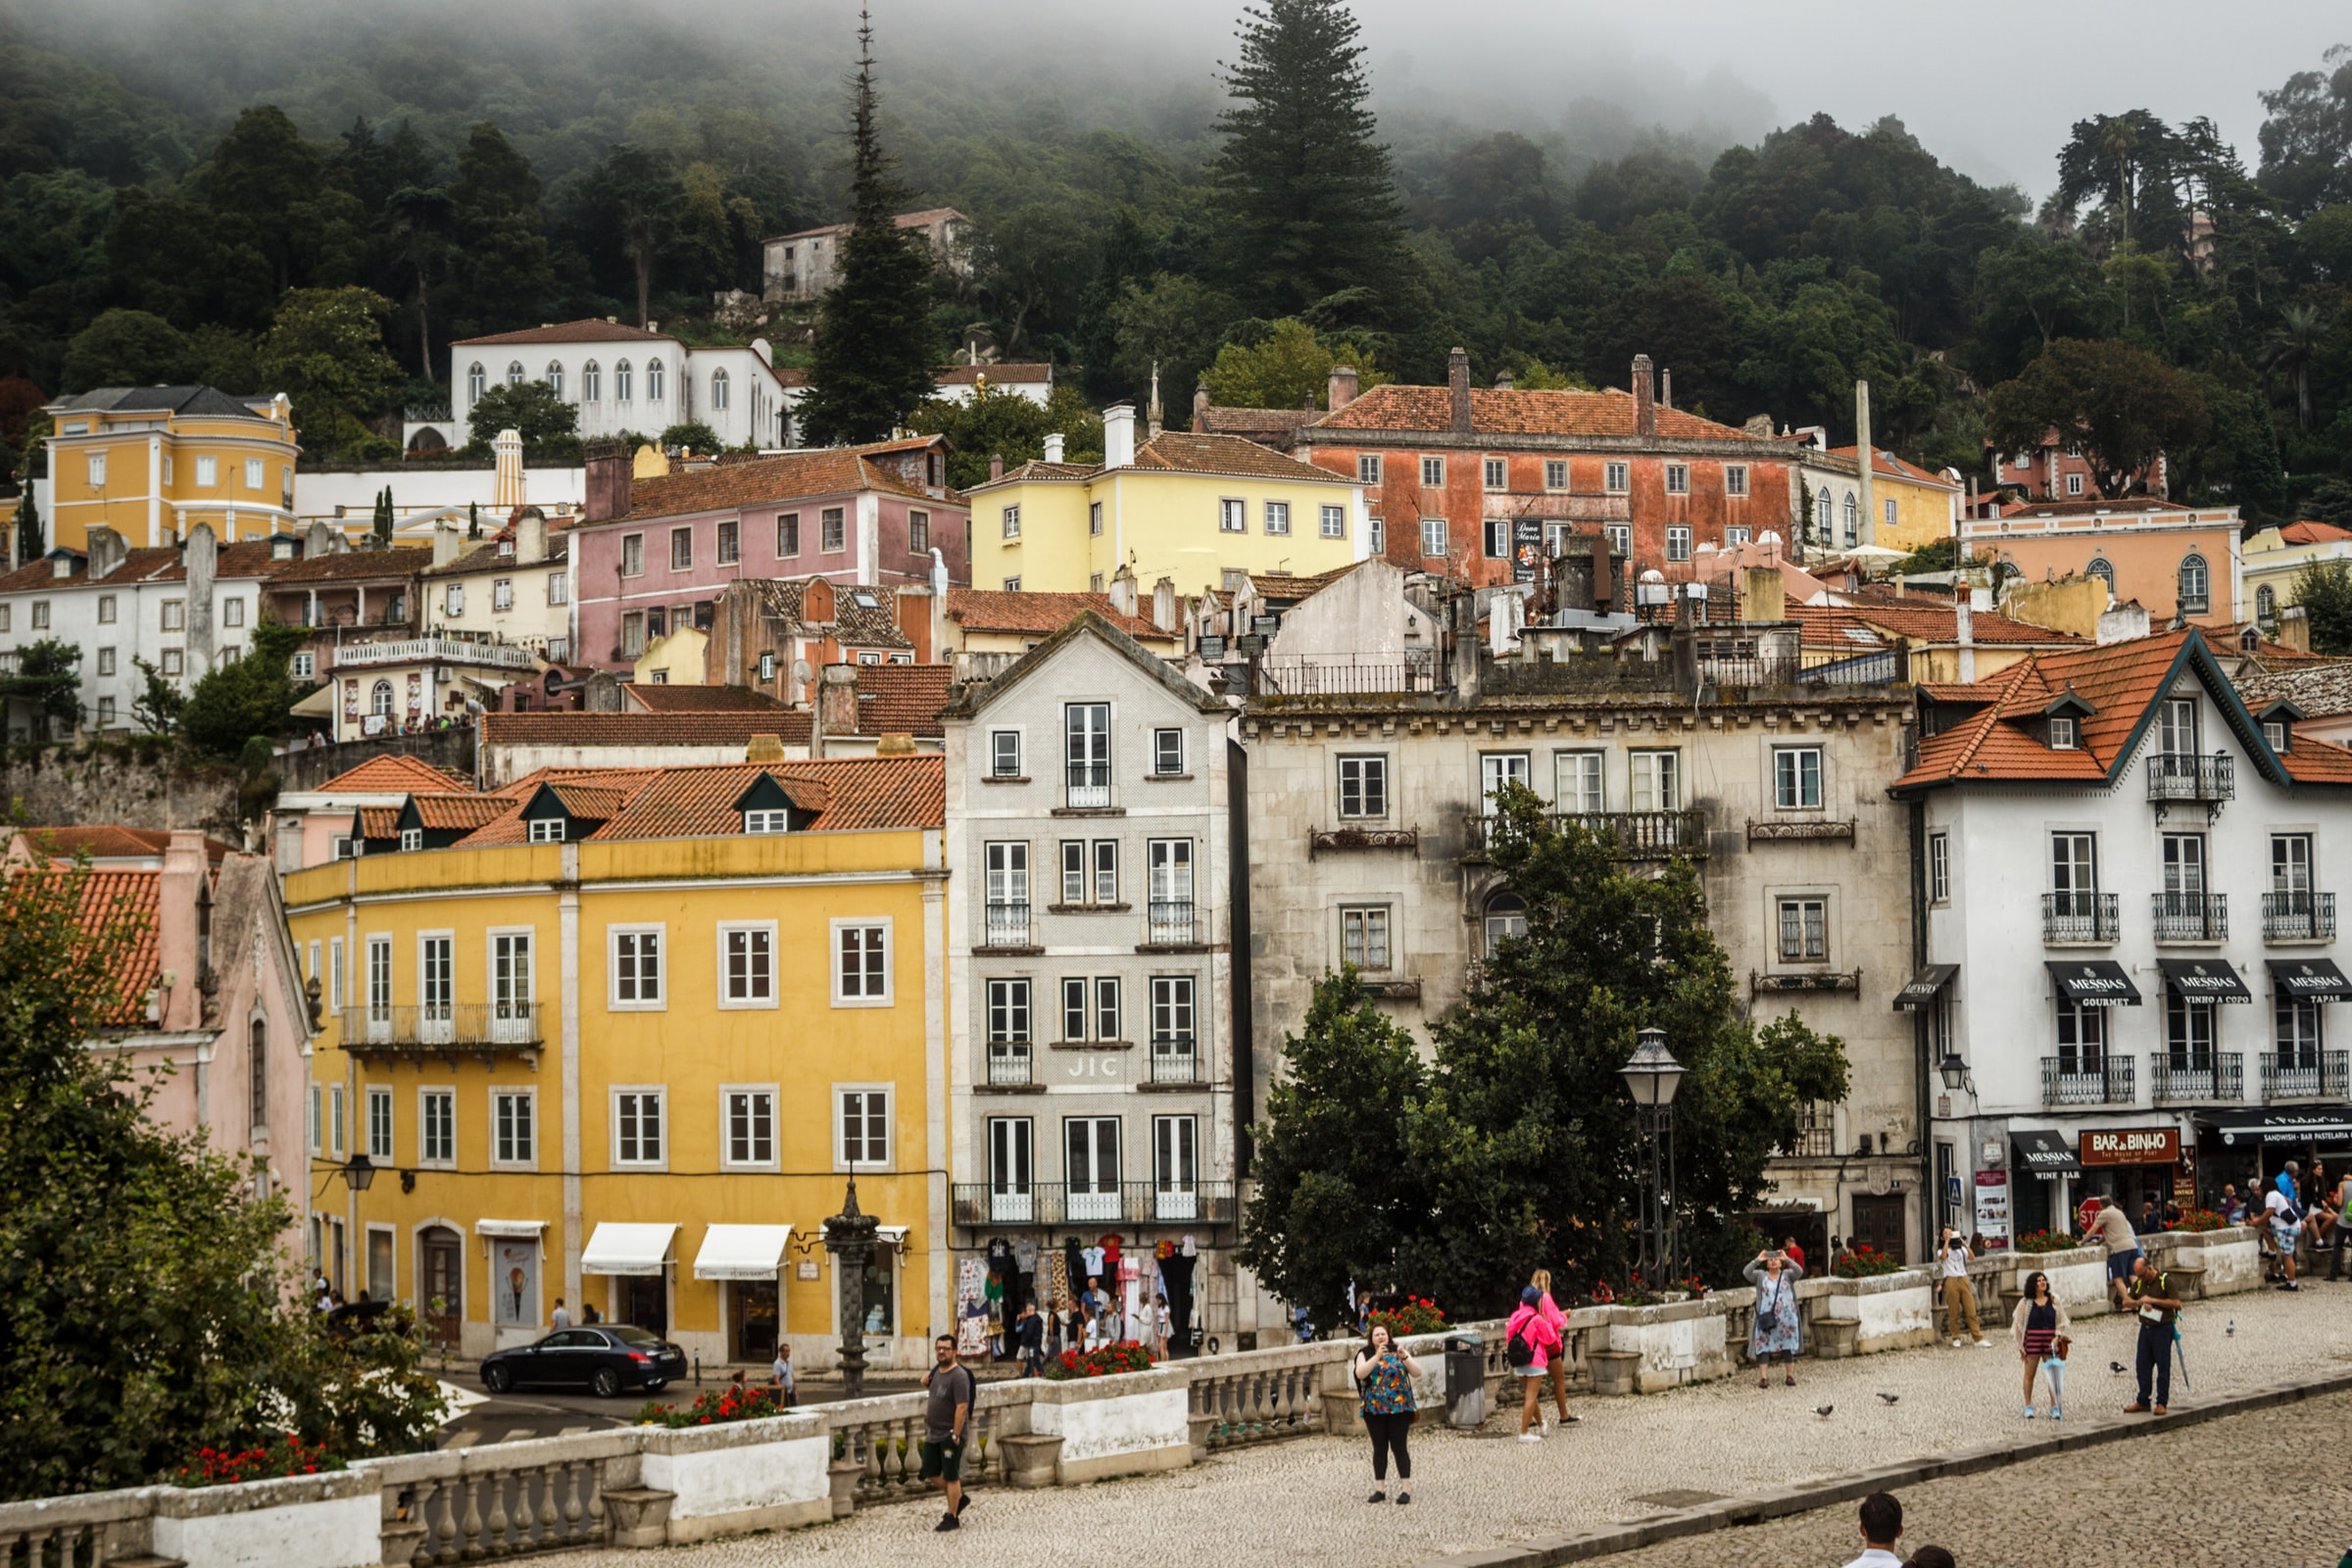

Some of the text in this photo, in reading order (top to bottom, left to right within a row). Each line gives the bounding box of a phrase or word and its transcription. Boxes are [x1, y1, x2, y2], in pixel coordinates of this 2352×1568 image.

[1516, 521, 1539, 532] Dona
[2068, 979, 2127, 990] MESSIAS
[2180, 977, 2236, 988] MESSIAS
[2288, 976, 2343, 988] MESSIAS
[2082, 998, 2130, 1006] GOURMET
[2310, 995, 2340, 1004] TAPAS
[1068, 1057, 1117, 1077] JIC
[2314, 1131, 2348, 1140] PASTELARIA
[2092, 1134, 2118, 1151] BAR
[2128, 1132, 2166, 1150] BINHO
[2026, 1152, 2074, 1162] MESSIAS
[2035, 1170, 2080, 1180] WINE BAR
[1090, 1254, 1097, 1265] 7
